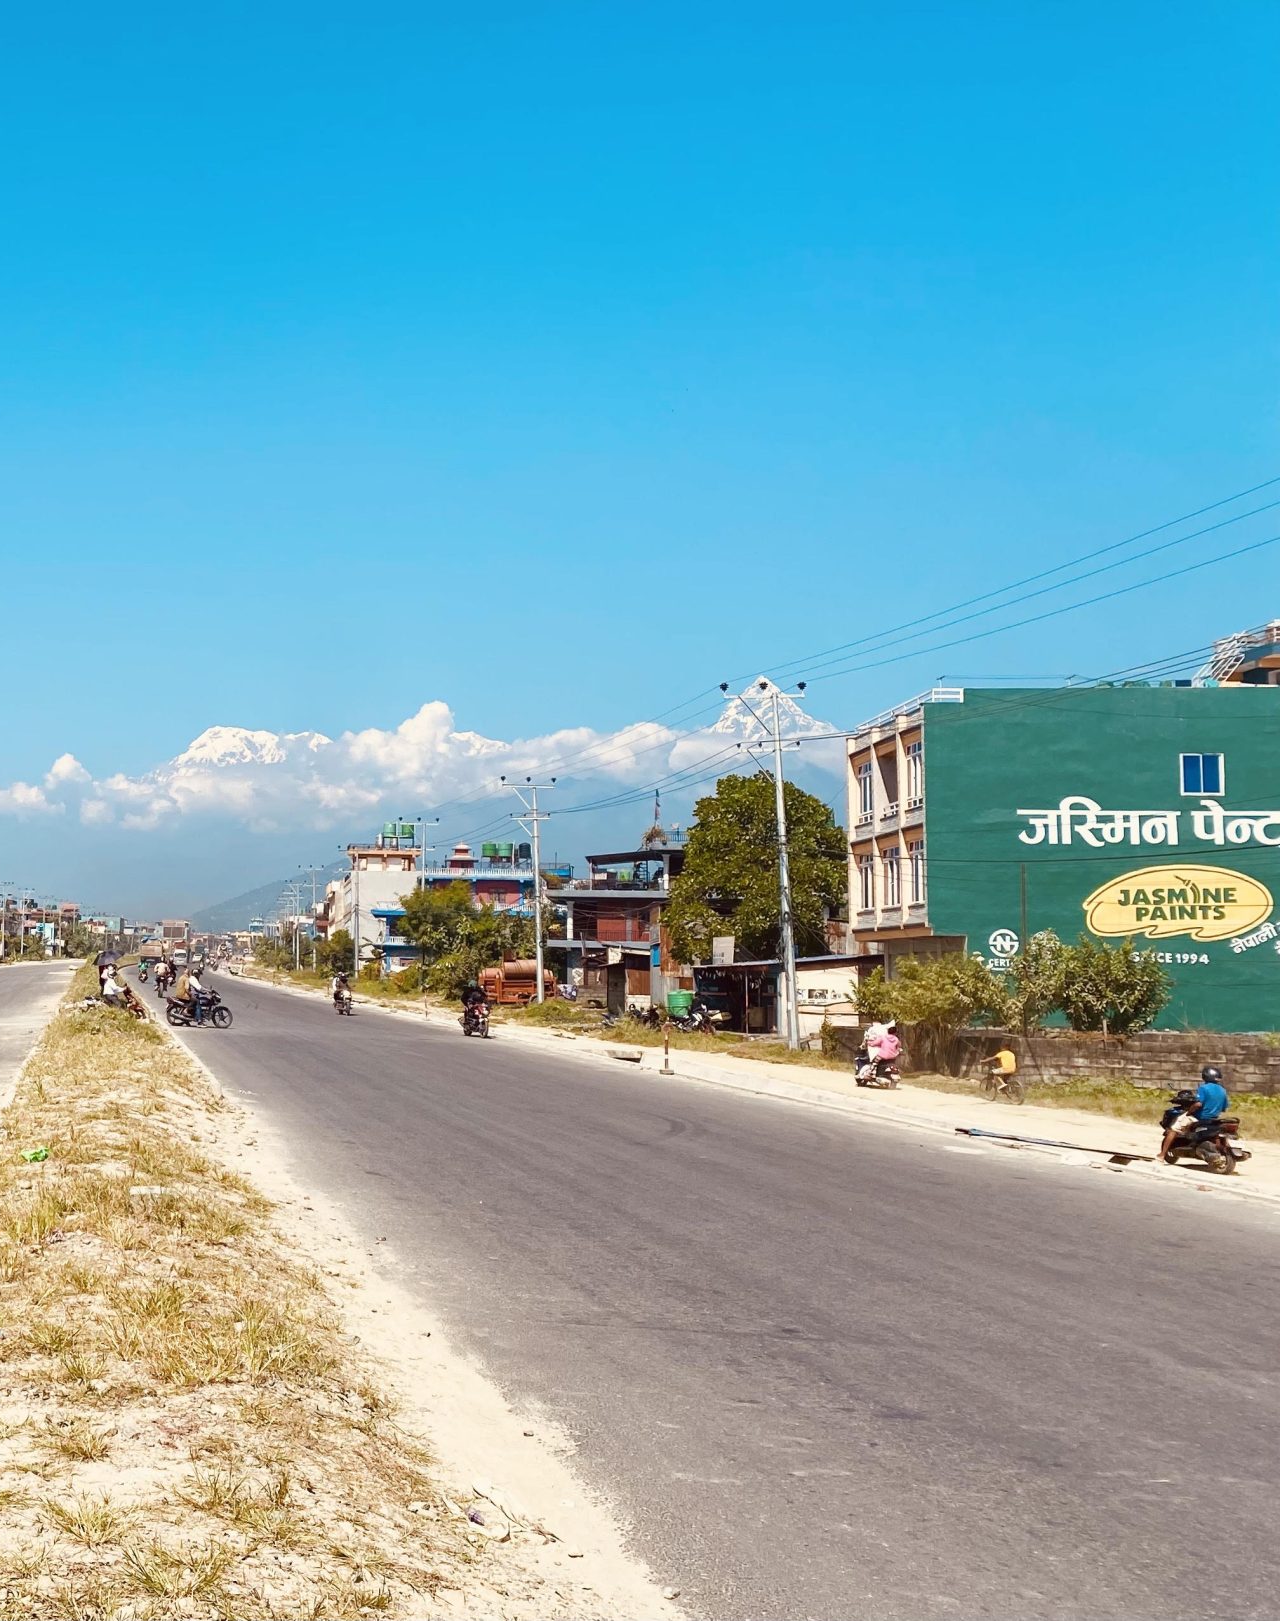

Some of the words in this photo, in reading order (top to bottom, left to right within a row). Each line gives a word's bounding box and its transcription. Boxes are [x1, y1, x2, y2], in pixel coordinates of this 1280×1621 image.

[1017, 796, 1181, 847] जस्मिन
[1118, 884, 1237, 906] JASMINE
[1136, 905, 1226, 921] PAINTS
[1175, 953, 1210, 965] 1994
